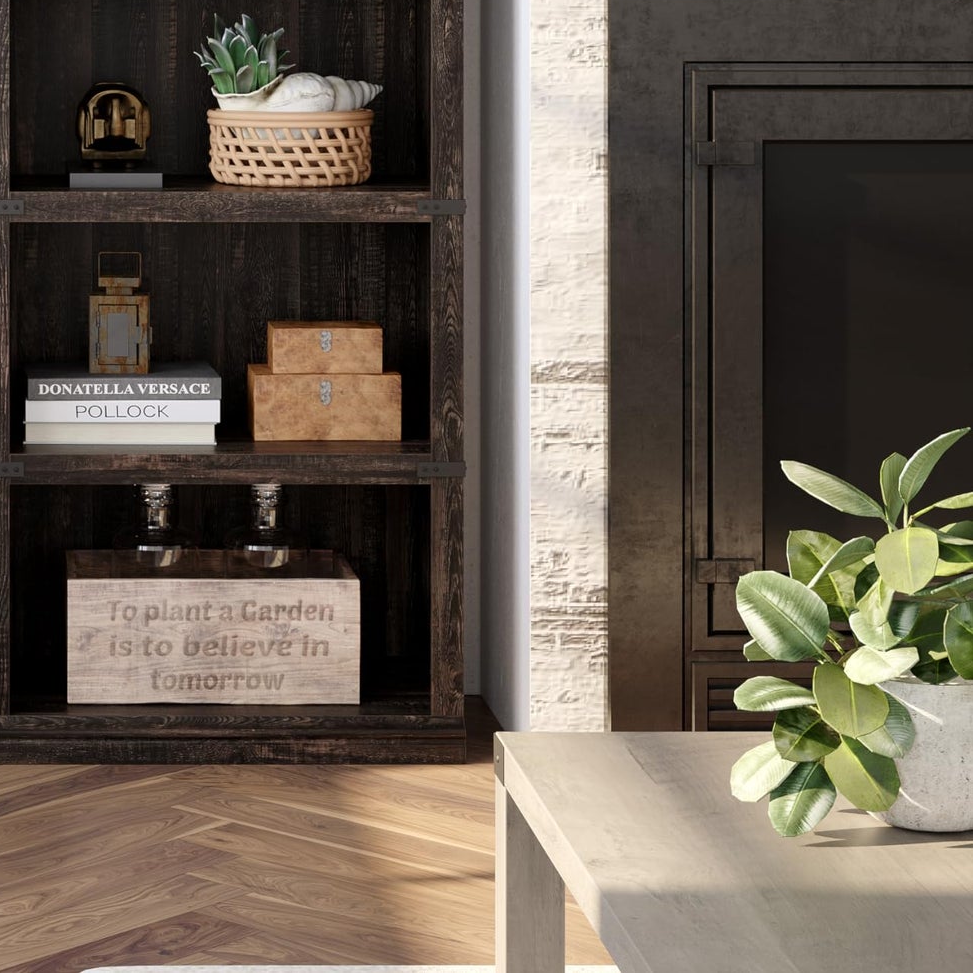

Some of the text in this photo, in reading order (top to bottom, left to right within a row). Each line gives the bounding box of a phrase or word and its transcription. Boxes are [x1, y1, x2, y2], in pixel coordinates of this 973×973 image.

[37, 383, 211, 395] DONATELLA VERSACE
[74, 404, 170, 419] POLLOCK
[107, 600, 334, 627] To plant a Garden
[109, 635, 329, 657] is to believe in
[151, 672, 285, 691] tomorrow
